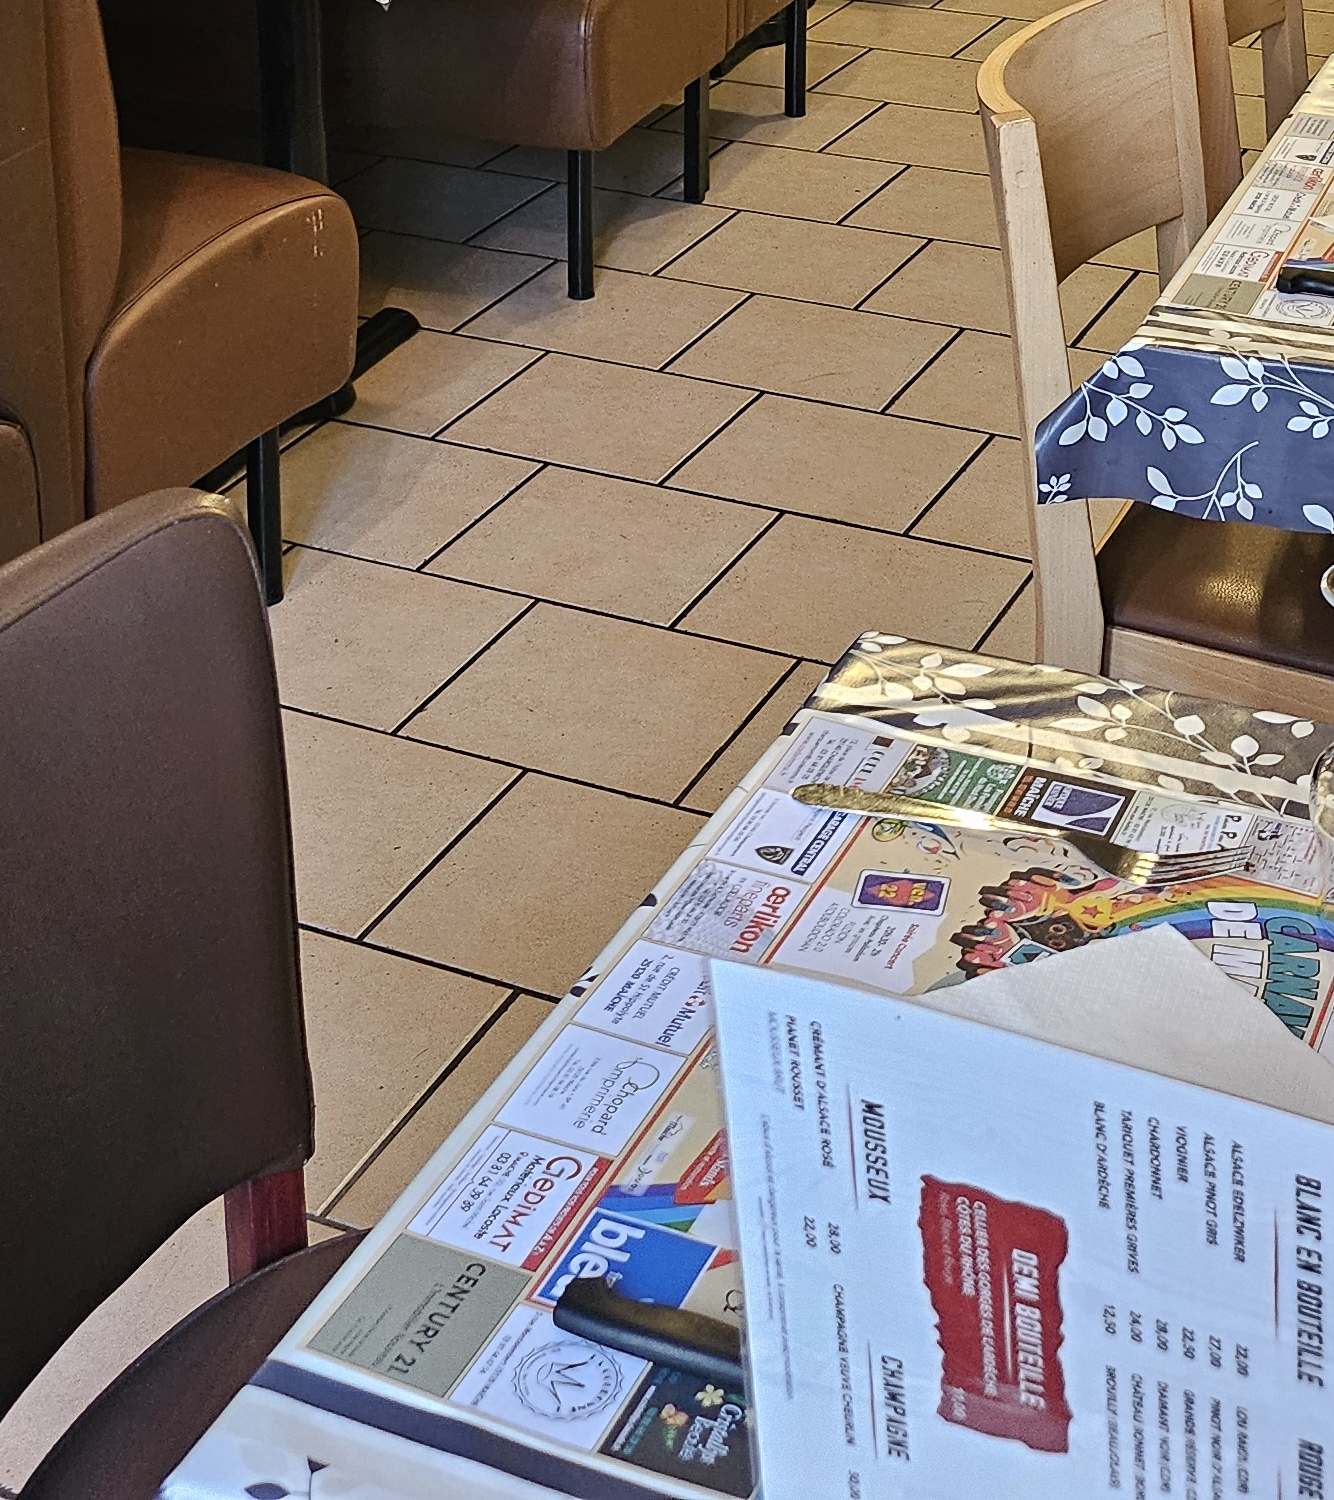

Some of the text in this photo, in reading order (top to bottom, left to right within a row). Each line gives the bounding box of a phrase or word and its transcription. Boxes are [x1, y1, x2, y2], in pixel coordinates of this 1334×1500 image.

[1017, 776, 1048, 819] MAÎCHE
[793, 840, 822, 872] CENTRAL
[724, 880, 771, 928] fineparts
[1207, 901, 1263, 941] DE
[603, 980, 635, 1012] MAÎCHE
[632, 967, 680, 1019] CRÉDIT MUTUEL
[646, 974, 657, 982] de
[653, 961, 666, 973] rue
[1265, 915, 1320, 1041] CARNAV
[611, 992, 642, 1024] Hippolyte
[655, 1007, 696, 1047] Mutuel
[591, 1076, 638, 1136] Chopard
[807, 1019, 843, 1255] CRÉMANT D'ALSACE ROSÉ 28,00
[1090, 1099, 1107, 1140] BLANC
[1119, 1105, 1135, 1161] TARIQUET
[496, 1152, 512, 1164] 03
[697, 1154, 729, 1191] Stands
[787, 1056, 805, 1112] ROUSSET
[802, 1214, 818, 1248] 22,00
[858, 1095, 892, 1207] MOUSSEUX
[1092, 1141, 1112, 1210] D'ARDÈCHE
[1147, 1116, 1163, 1200] CHARDONNET
[1175, 1124, 1189, 1183] VIOGNIER
[474, 1154, 546, 1240] Matériaux Lacoste
[1122, 1163, 1138, 1231] PREMIÈRES
[953, 1195, 975, 1297] CÔTES DU RHÔNE
[972, 1200, 994, 1336] CELLIER DES GORGES DE
[1125, 1232, 1140, 1275] GRIVES
[1202, 1132, 1222, 1368] ALSACE PINOT GRIS 27,00
[1230, 1139, 1249, 1377] ALSACE EDELZWIKER 22,00
[1293, 1171, 1324, 1390] BLANC EN BOUTEILLE
[392, 1263, 487, 1377] CENTURY 21
[830, 1282, 850, 1356] CHAMPAGNE
[1009, 1246, 1047, 1411] DEMI BOUTEILLE
[879, 1352, 910, 1464] CHAMPAGNE
[1296, 1435, 1323, 1500] ROUGE
